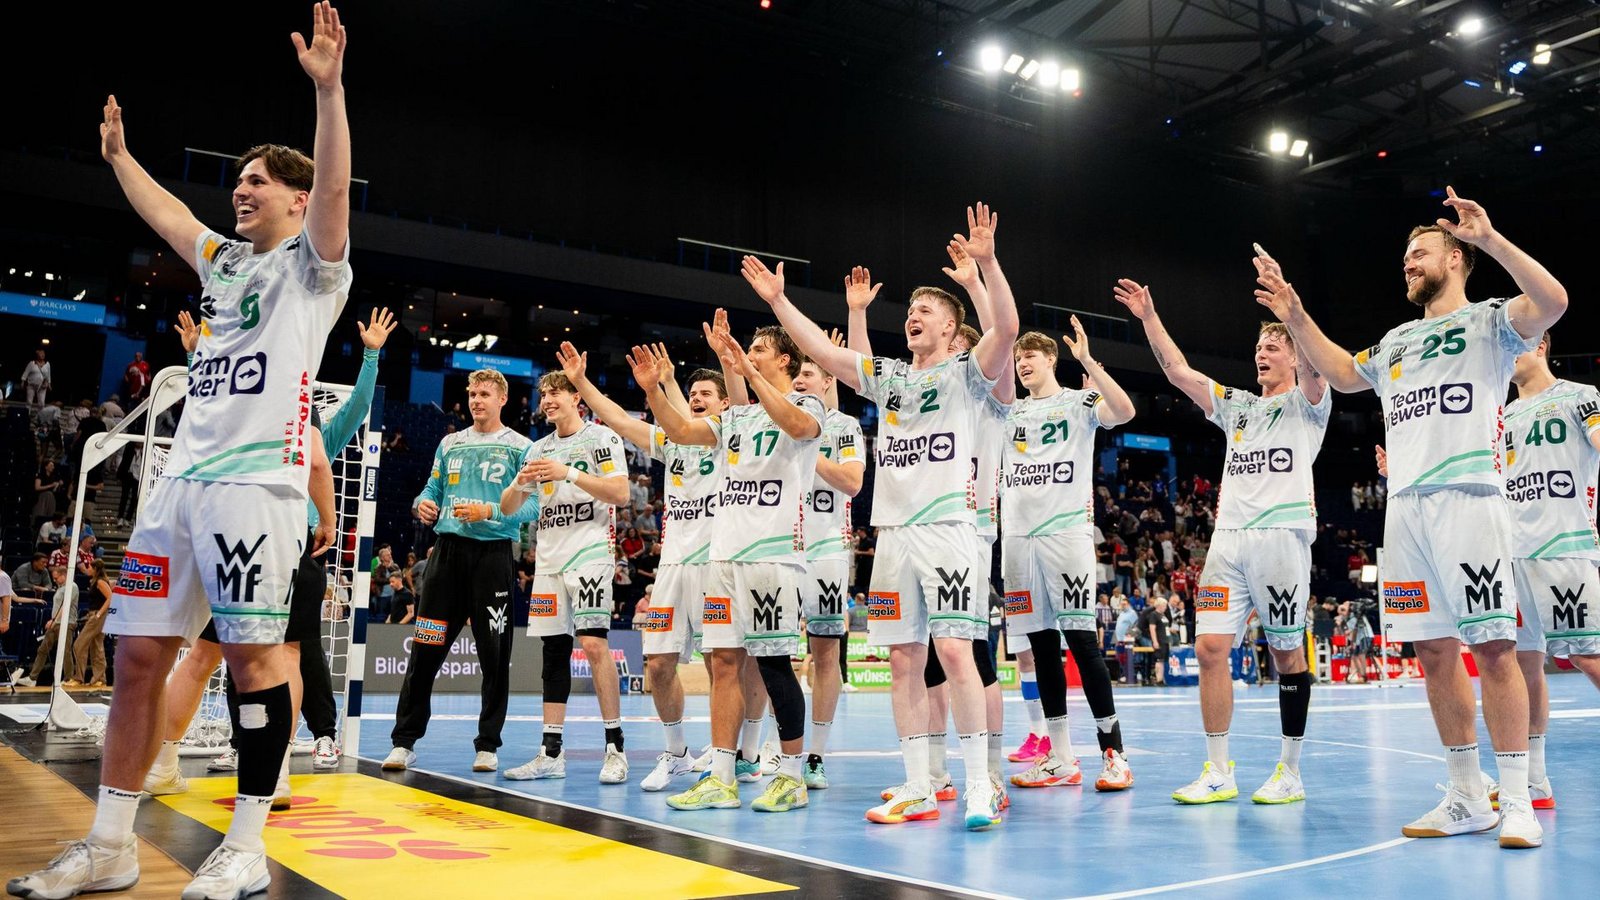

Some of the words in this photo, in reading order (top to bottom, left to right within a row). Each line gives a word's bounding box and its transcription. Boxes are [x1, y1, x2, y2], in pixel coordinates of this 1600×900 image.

[39, 300, 76, 312] BARCLAYS
[240, 292, 260, 330] 9
[1419, 327, 1466, 361] 25
[919, 388, 940, 414] 2
[1390, 386, 1437, 412] Team
[752, 430, 780, 457] 17
[1041, 419, 1069, 445] 21
[1525, 417, 1567, 447] 40
[699, 452, 715, 476] 5
[1231, 447, 1265, 464] eam
[480, 461, 506, 484] 12
[1012, 462, 1051, 476] Team
[1506, 471, 1545, 492] eam
[1384, 586, 1422, 597] ahlbau
[108, 788, 142, 799] Kemp
